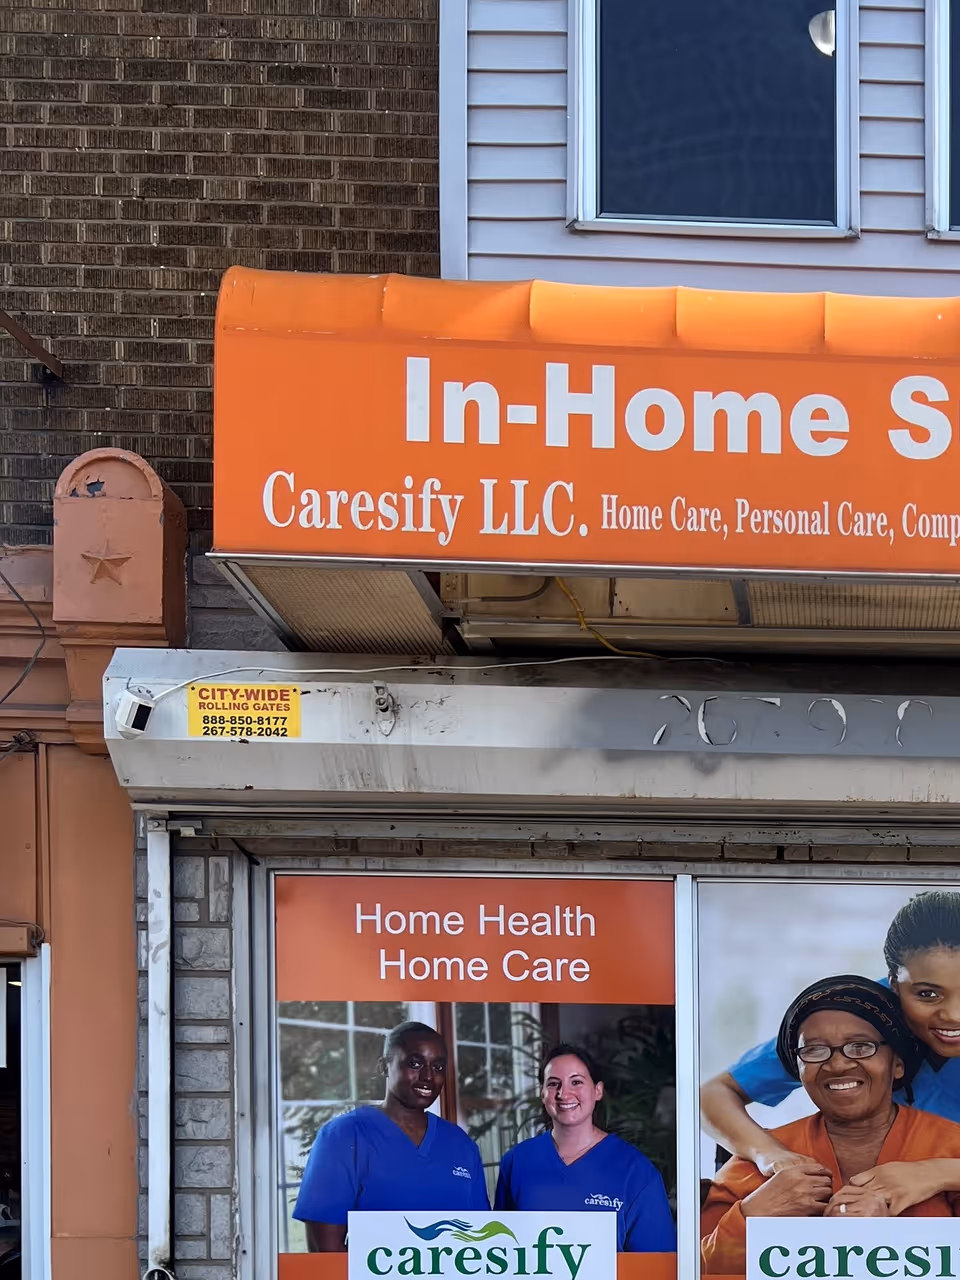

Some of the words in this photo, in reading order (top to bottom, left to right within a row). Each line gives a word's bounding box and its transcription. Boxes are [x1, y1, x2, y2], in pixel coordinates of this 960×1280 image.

[405, 356, 849, 458] In-Home
[262, 470, 464, 546] Caresify
[479, 479, 588, 537] LLC.
[601, 494, 663, 530] Home
[670, 496, 728, 540] Care,
[735, 498, 830, 535] Personal
[837, 501, 895, 545] Care,
[199, 688, 290, 701] CITY-WIDE
[199, 702, 249, 710] ROLLING
[253, 703, 290, 711] GATES
[203, 716, 287, 725] 888-850-8177
[203, 726, 288, 737] 267-578-2042
[355, 903, 464, 935] Home
[479, 905, 596, 936] Health
[380, 949, 488, 980] Home
[502, 950, 590, 982] Care
